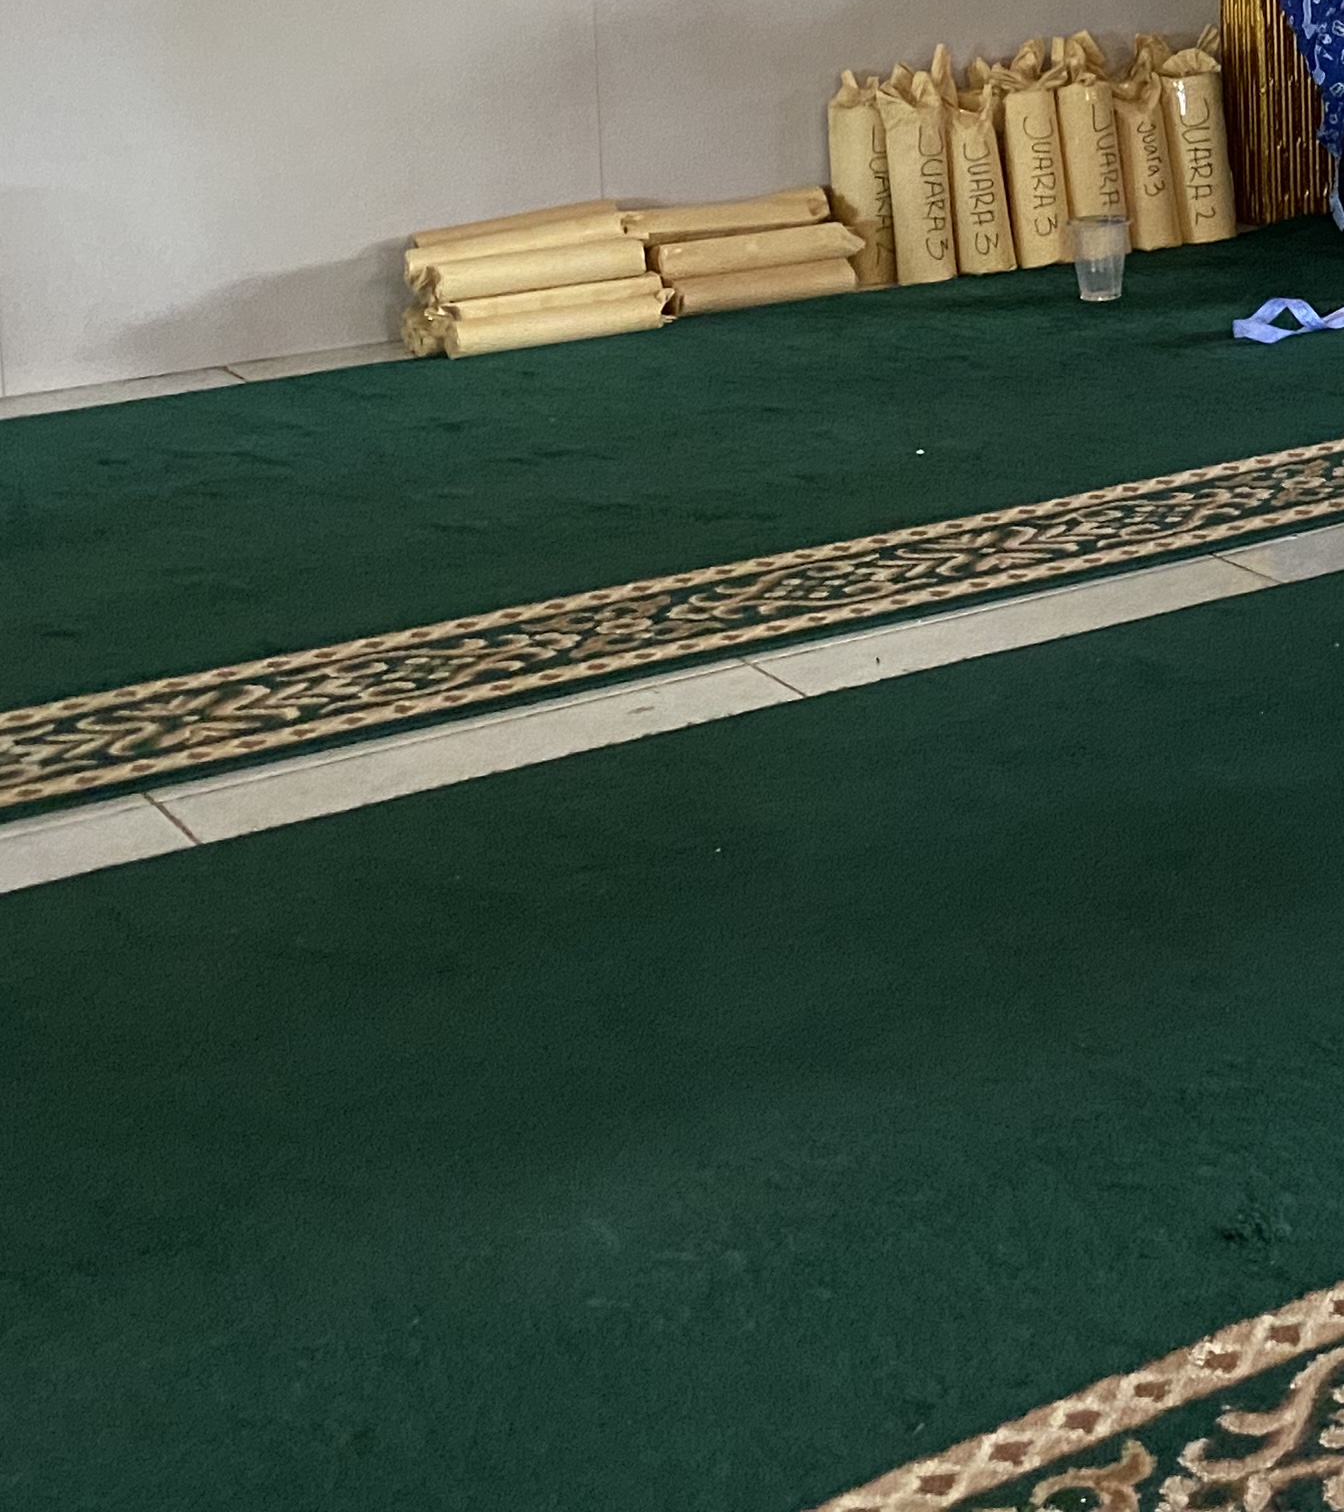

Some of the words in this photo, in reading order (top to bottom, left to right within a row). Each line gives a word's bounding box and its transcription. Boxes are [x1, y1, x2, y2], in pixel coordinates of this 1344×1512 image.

[1022, 115, 1057, 210] JUARA
[1091, 103, 1120, 208] JUARA
[1179, 97, 1214, 201] JUARA
[918, 125, 946, 233] JUARA
[963, 140, 995, 226] JUARA
[1143, 179, 1166, 197] 3
[974, 232, 999, 255] 3
[1034, 212, 1058, 237] 3
[1195, 206, 1217, 226] 2
[925, 237, 949, 261] 3
